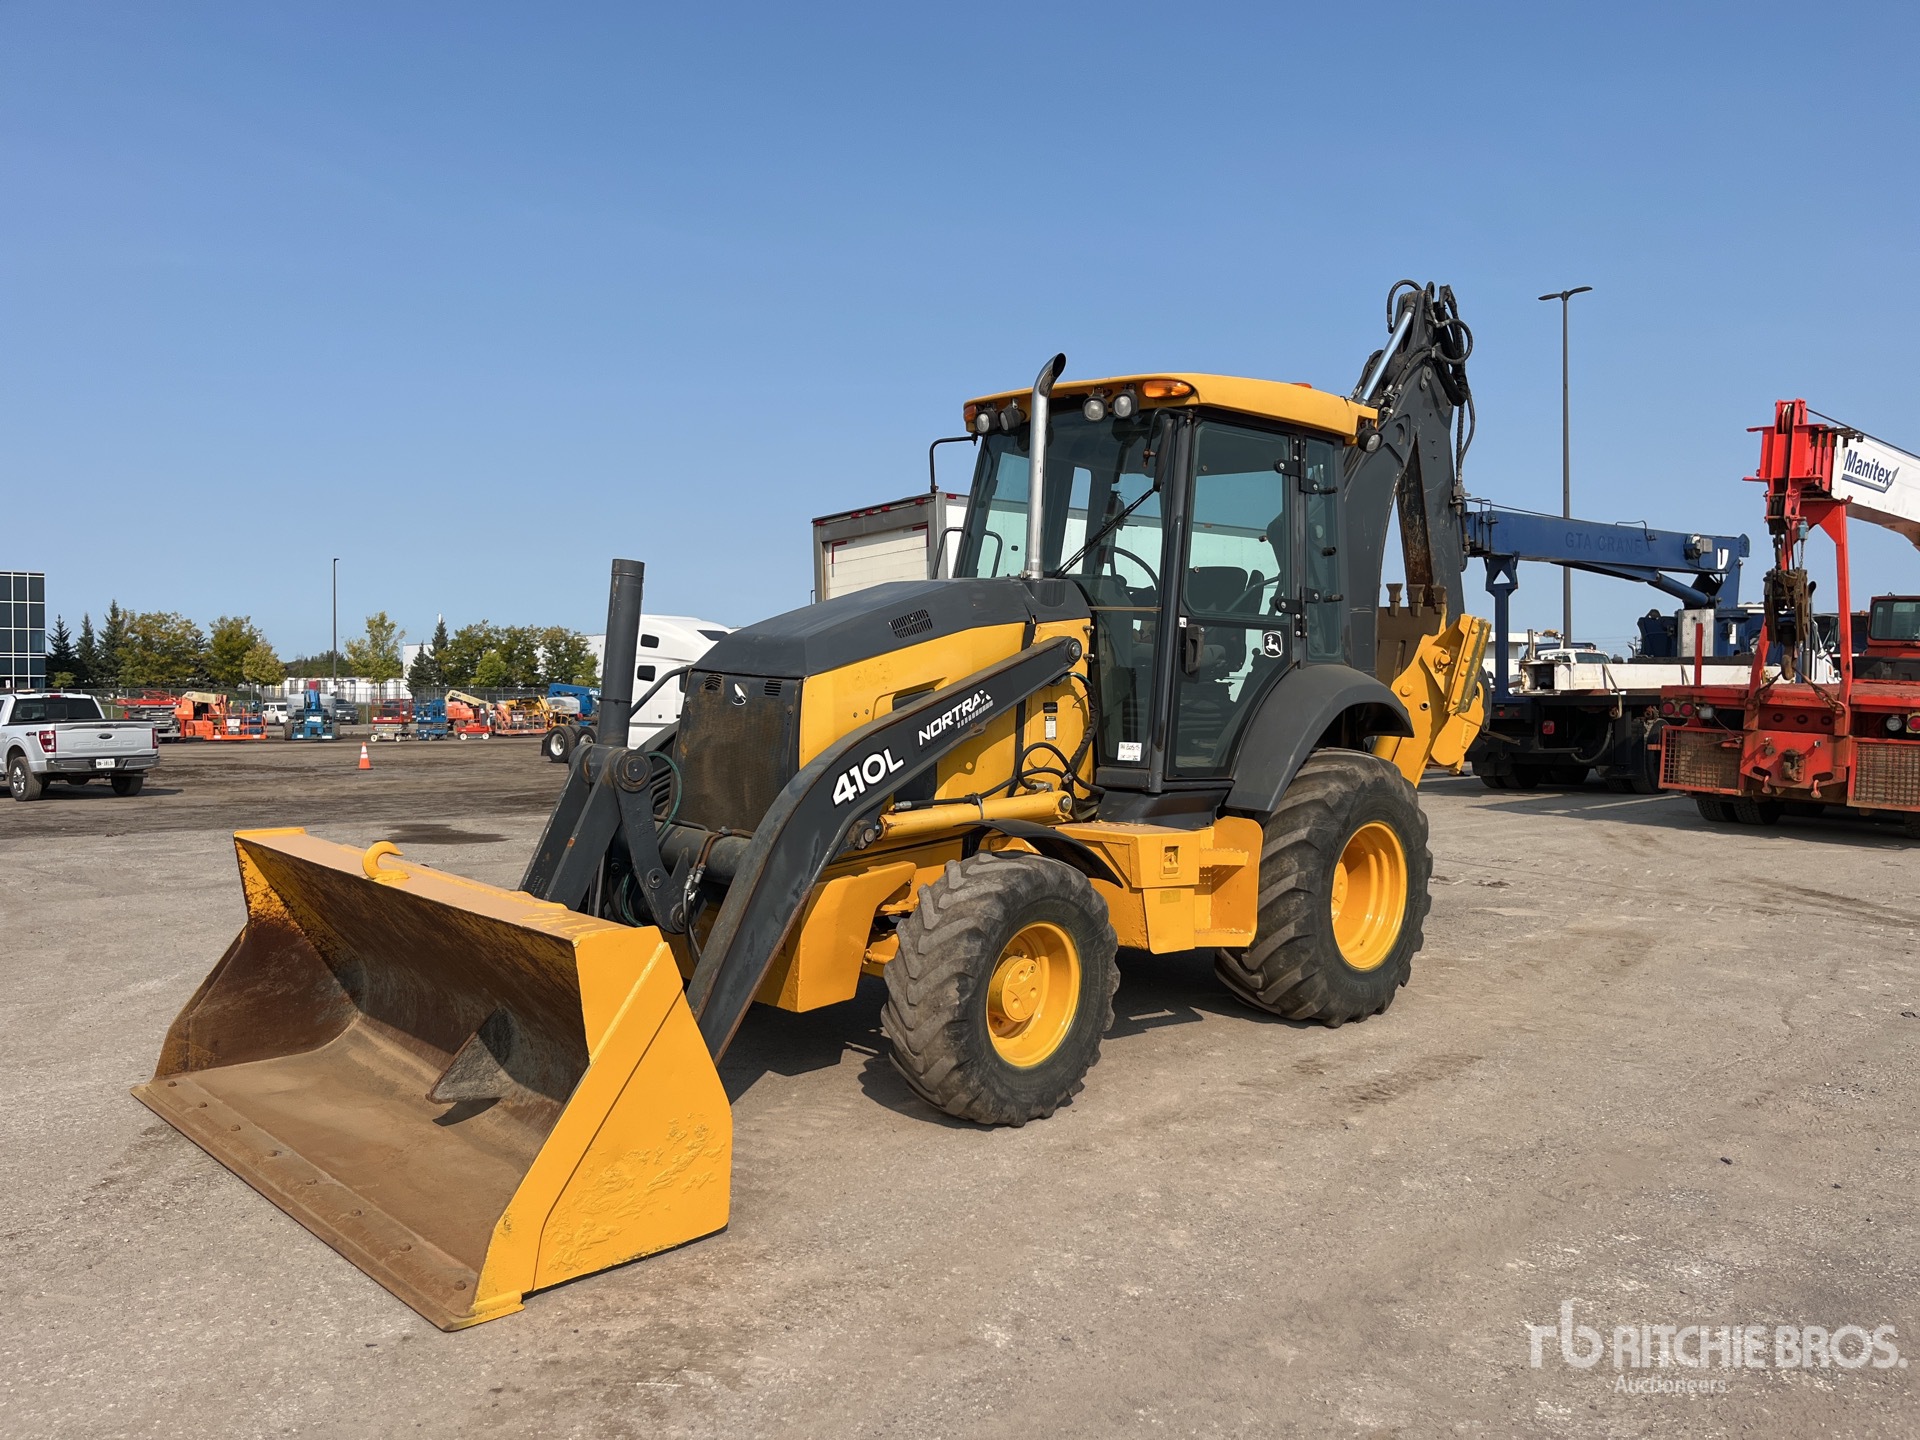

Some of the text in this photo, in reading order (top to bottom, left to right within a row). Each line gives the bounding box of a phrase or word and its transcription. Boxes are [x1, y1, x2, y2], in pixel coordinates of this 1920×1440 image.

[1844, 449, 1892, 485] Manitex
[1565, 531, 1643, 554] GTA CRANE
[918, 689, 992, 747] NORTRAX
[832, 748, 905, 806] 410L
